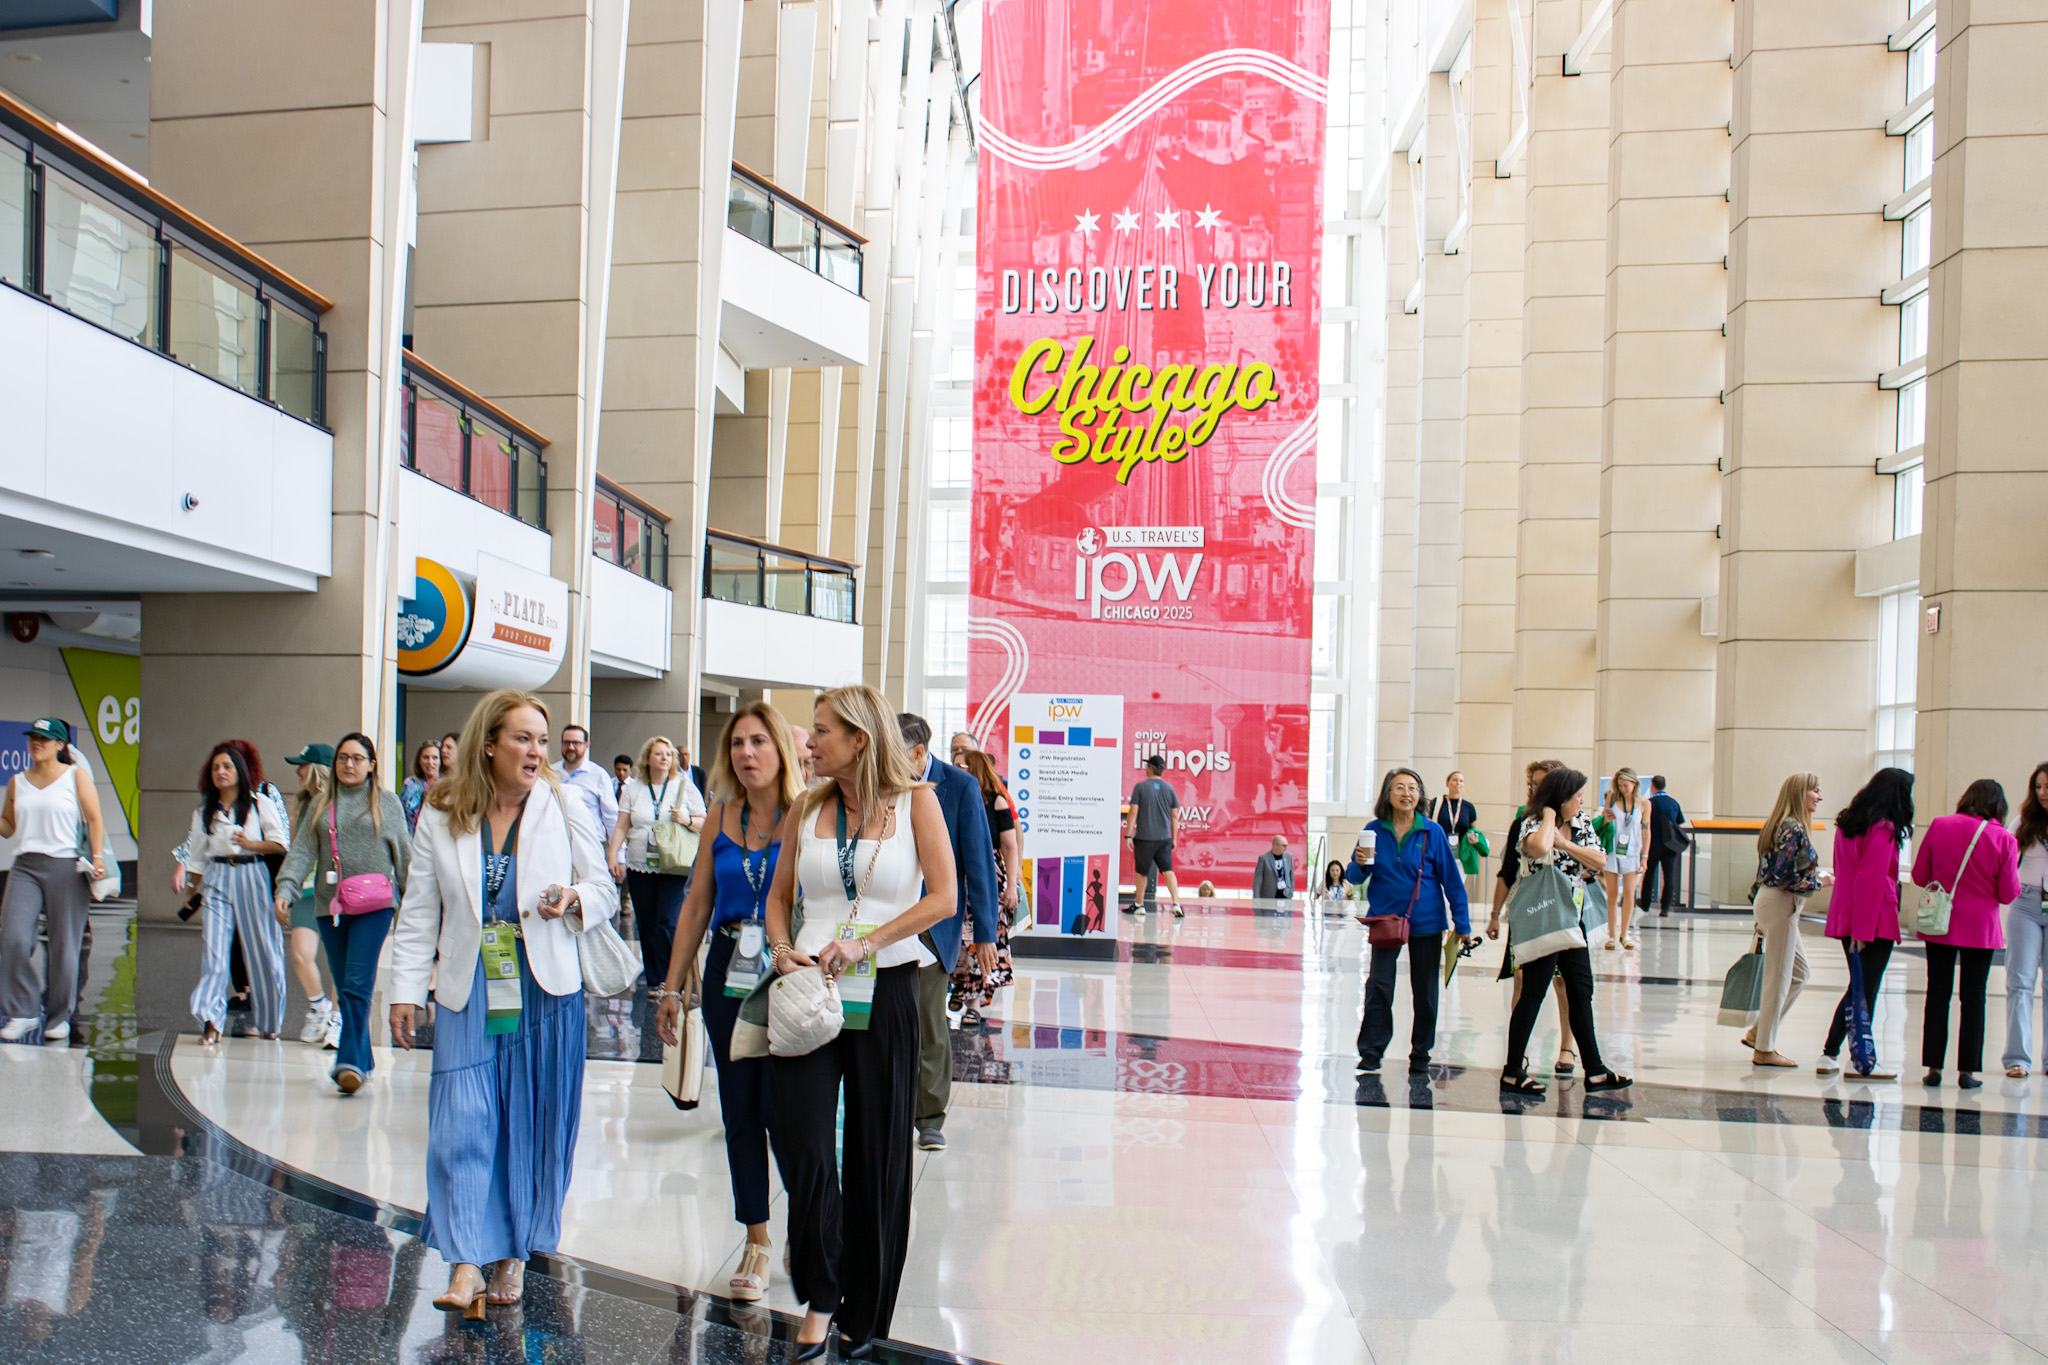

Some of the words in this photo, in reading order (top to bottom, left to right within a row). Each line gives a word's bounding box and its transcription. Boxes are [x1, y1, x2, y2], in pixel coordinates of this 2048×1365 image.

[1002, 264, 1179, 313] DISCOVER
[1197, 261, 1292, 308] YOUR
[1009, 336, 1280, 449] Chicago
[1051, 401, 1189, 485] Style
[1112, 530, 1136, 543] U.S.
[1141, 530, 1200, 543] TRAVEL'S
[1075, 551, 1204, 620] ipw
[490, 598, 501, 615] THE
[503, 591, 545, 626] PLATE
[1104, 605, 1160, 620] CHICAGO
[1163, 605, 1193, 620] 2025
[500, 627, 520, 641] FOOD
[523, 634, 547, 647] COURT
[1048, 704, 1083, 722] ipw
[1135, 729, 1166, 743] enjoy
